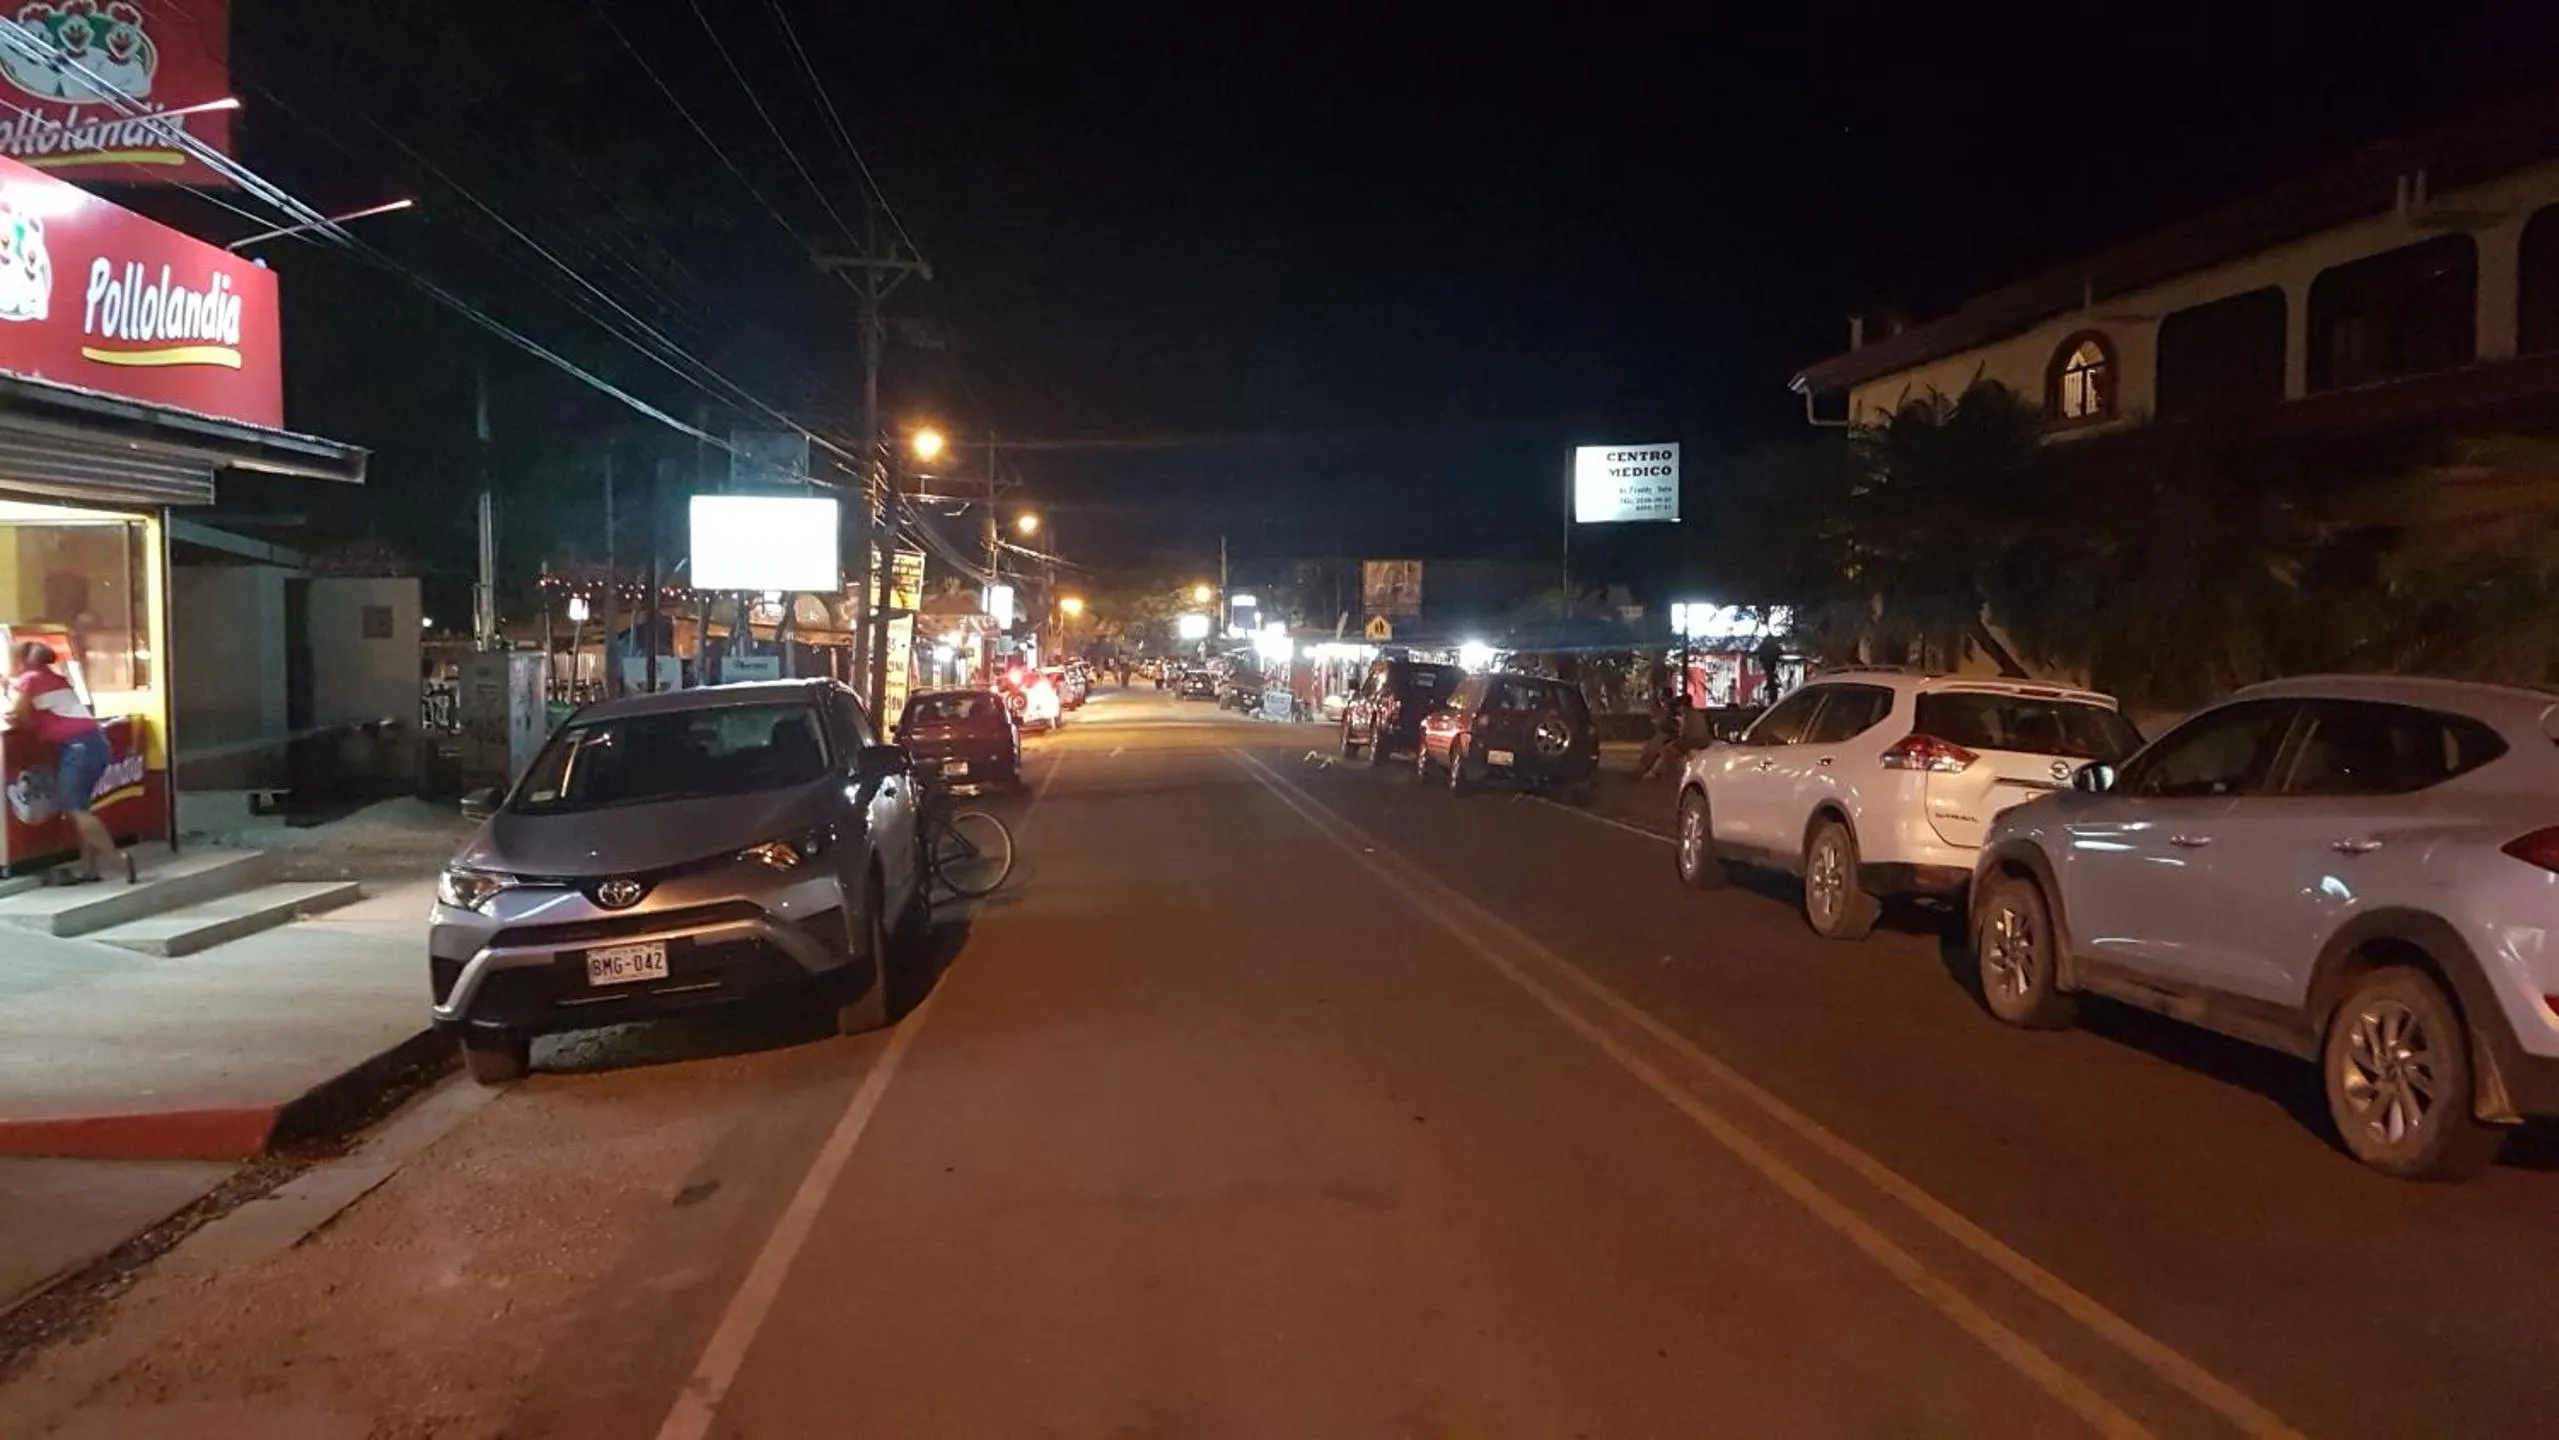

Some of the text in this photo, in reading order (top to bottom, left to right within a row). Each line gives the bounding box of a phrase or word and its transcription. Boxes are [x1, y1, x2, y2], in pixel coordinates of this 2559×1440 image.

[84, 256, 243, 345] Pollolandia
[1606, 450, 1672, 462] CENTRO
[592, 952, 663, 976] BMG-042
